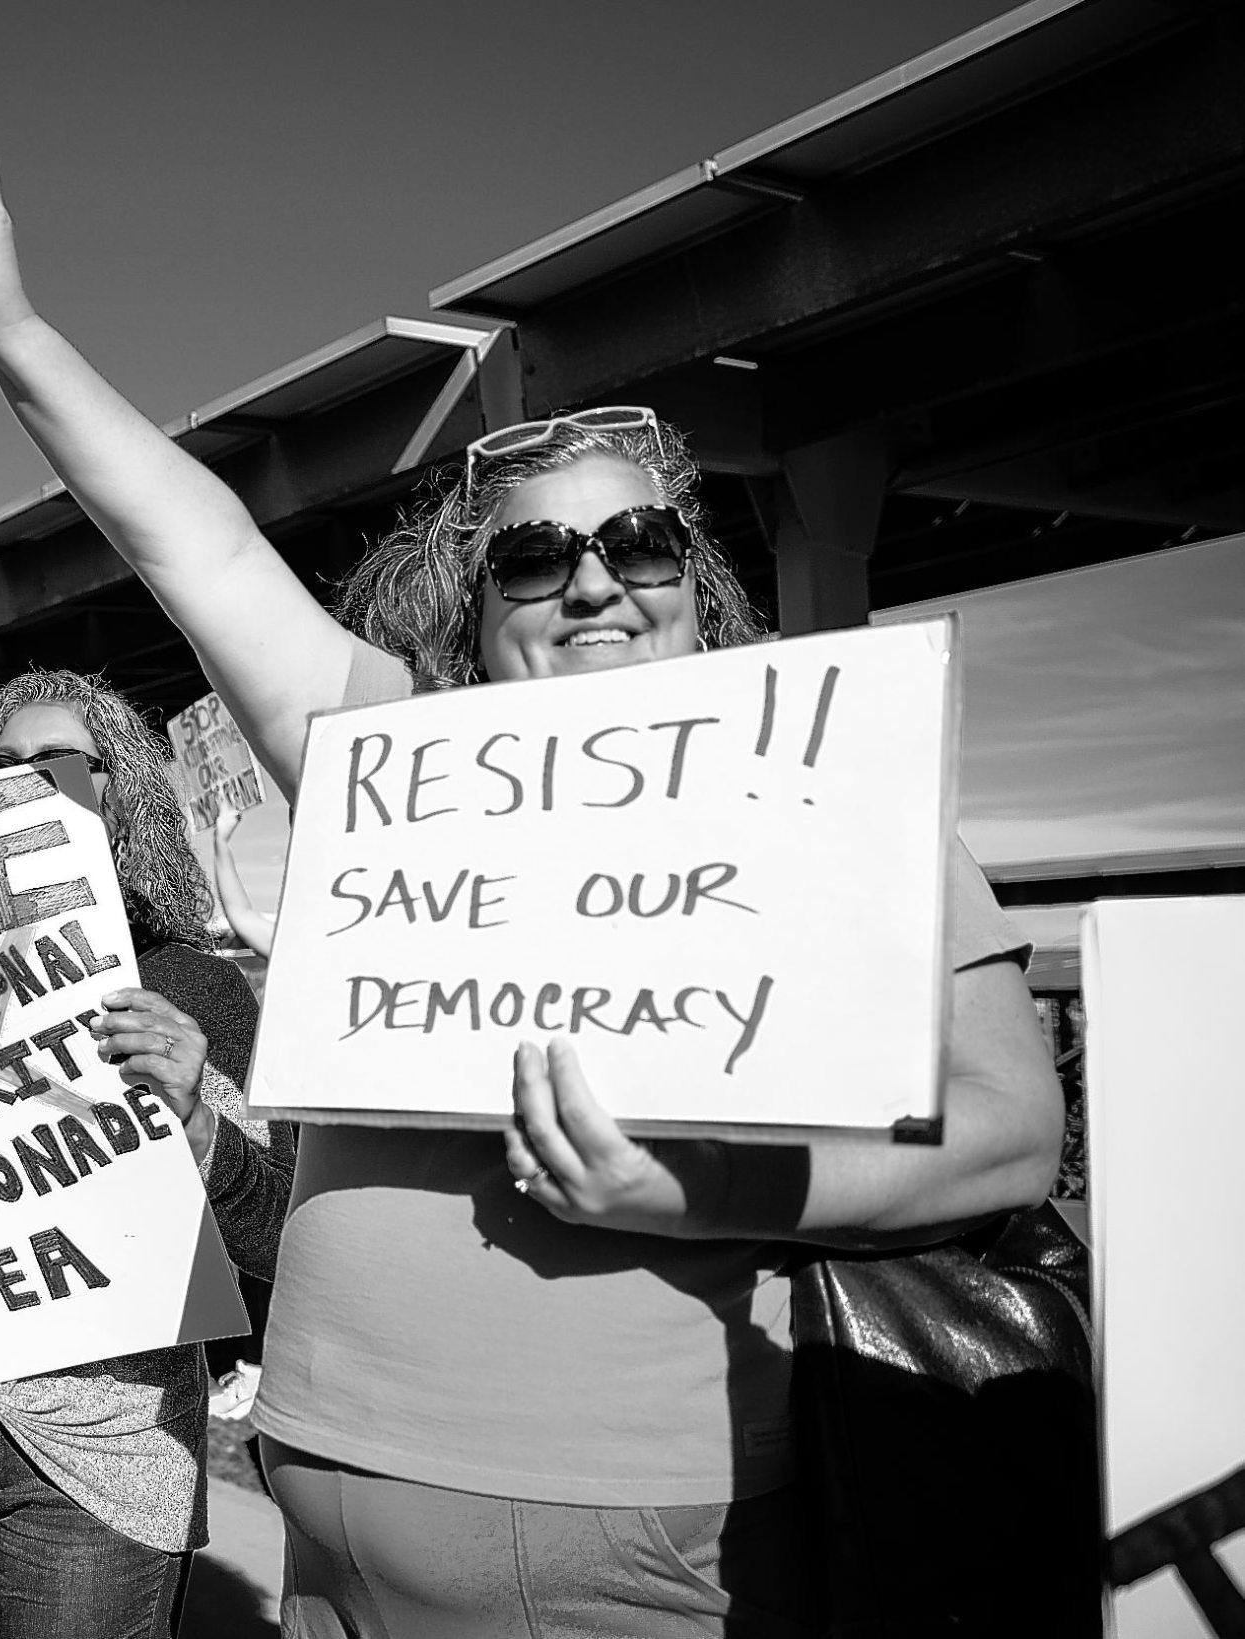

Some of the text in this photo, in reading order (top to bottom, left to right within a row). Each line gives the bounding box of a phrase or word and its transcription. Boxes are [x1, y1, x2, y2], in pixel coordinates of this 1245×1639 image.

[325, 862, 761, 937] SAVE OUR
[337, 974, 775, 1075] DEMOCRACY
